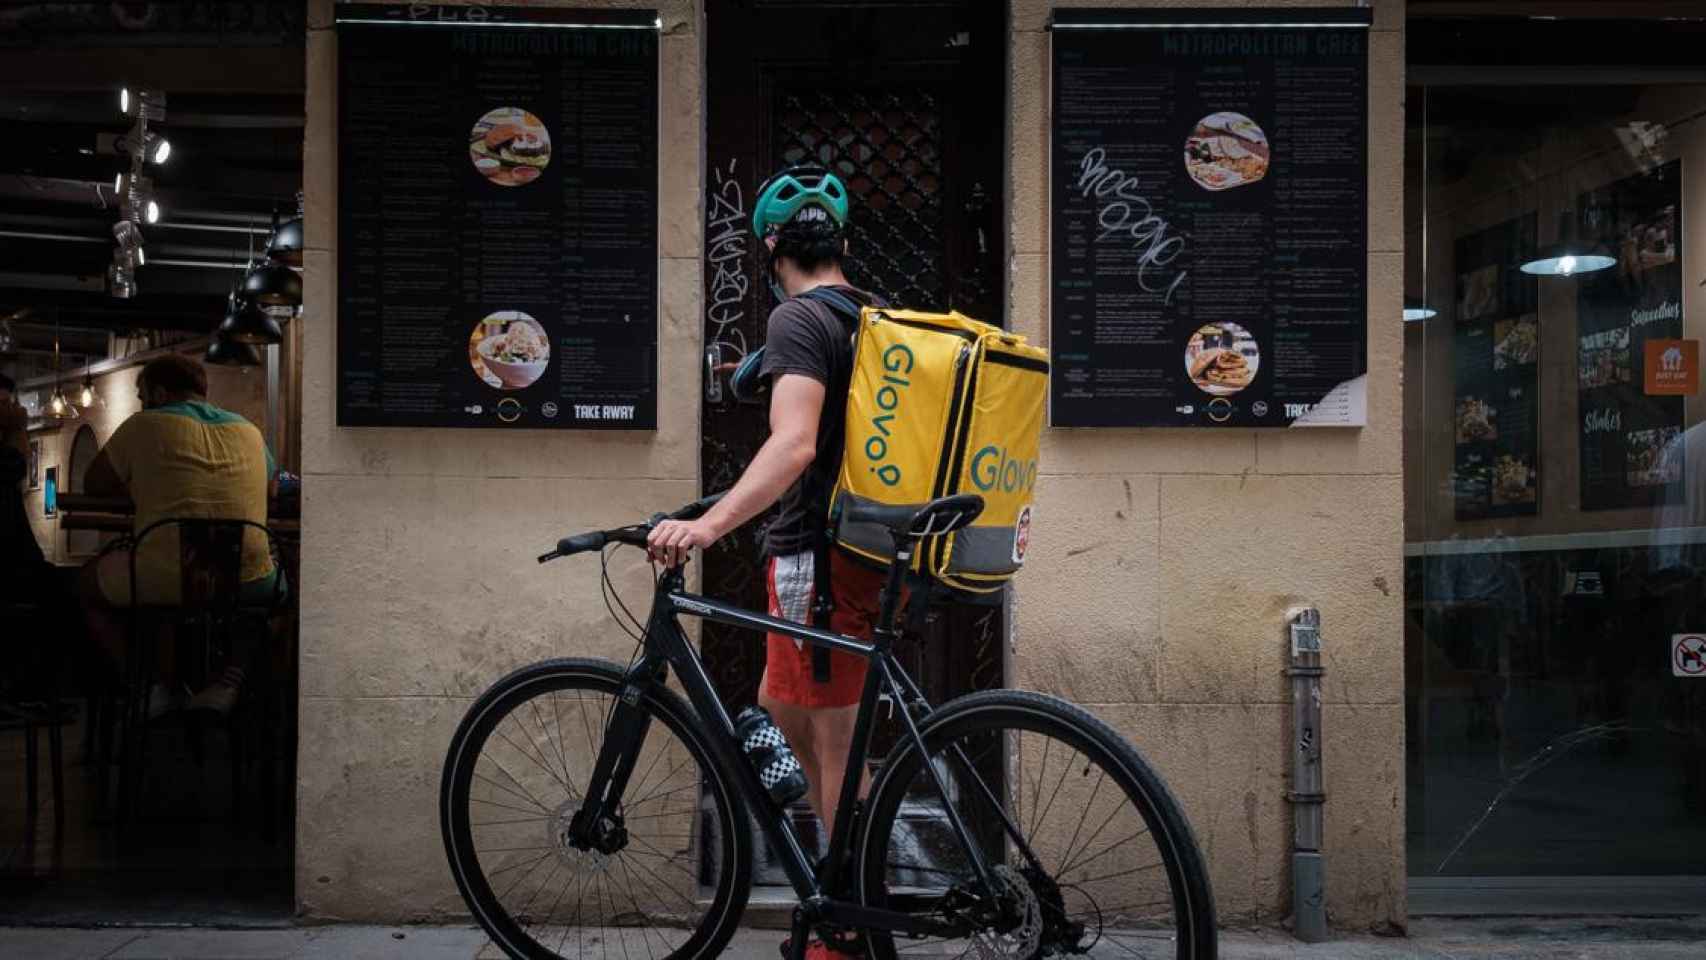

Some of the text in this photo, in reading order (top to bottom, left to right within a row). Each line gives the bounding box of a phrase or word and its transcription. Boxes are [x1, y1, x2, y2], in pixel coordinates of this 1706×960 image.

[574, 404, 635, 419] TAKE AWAY
[865, 343, 915, 461] Glovo
[971, 445, 1037, 493] Glovo
